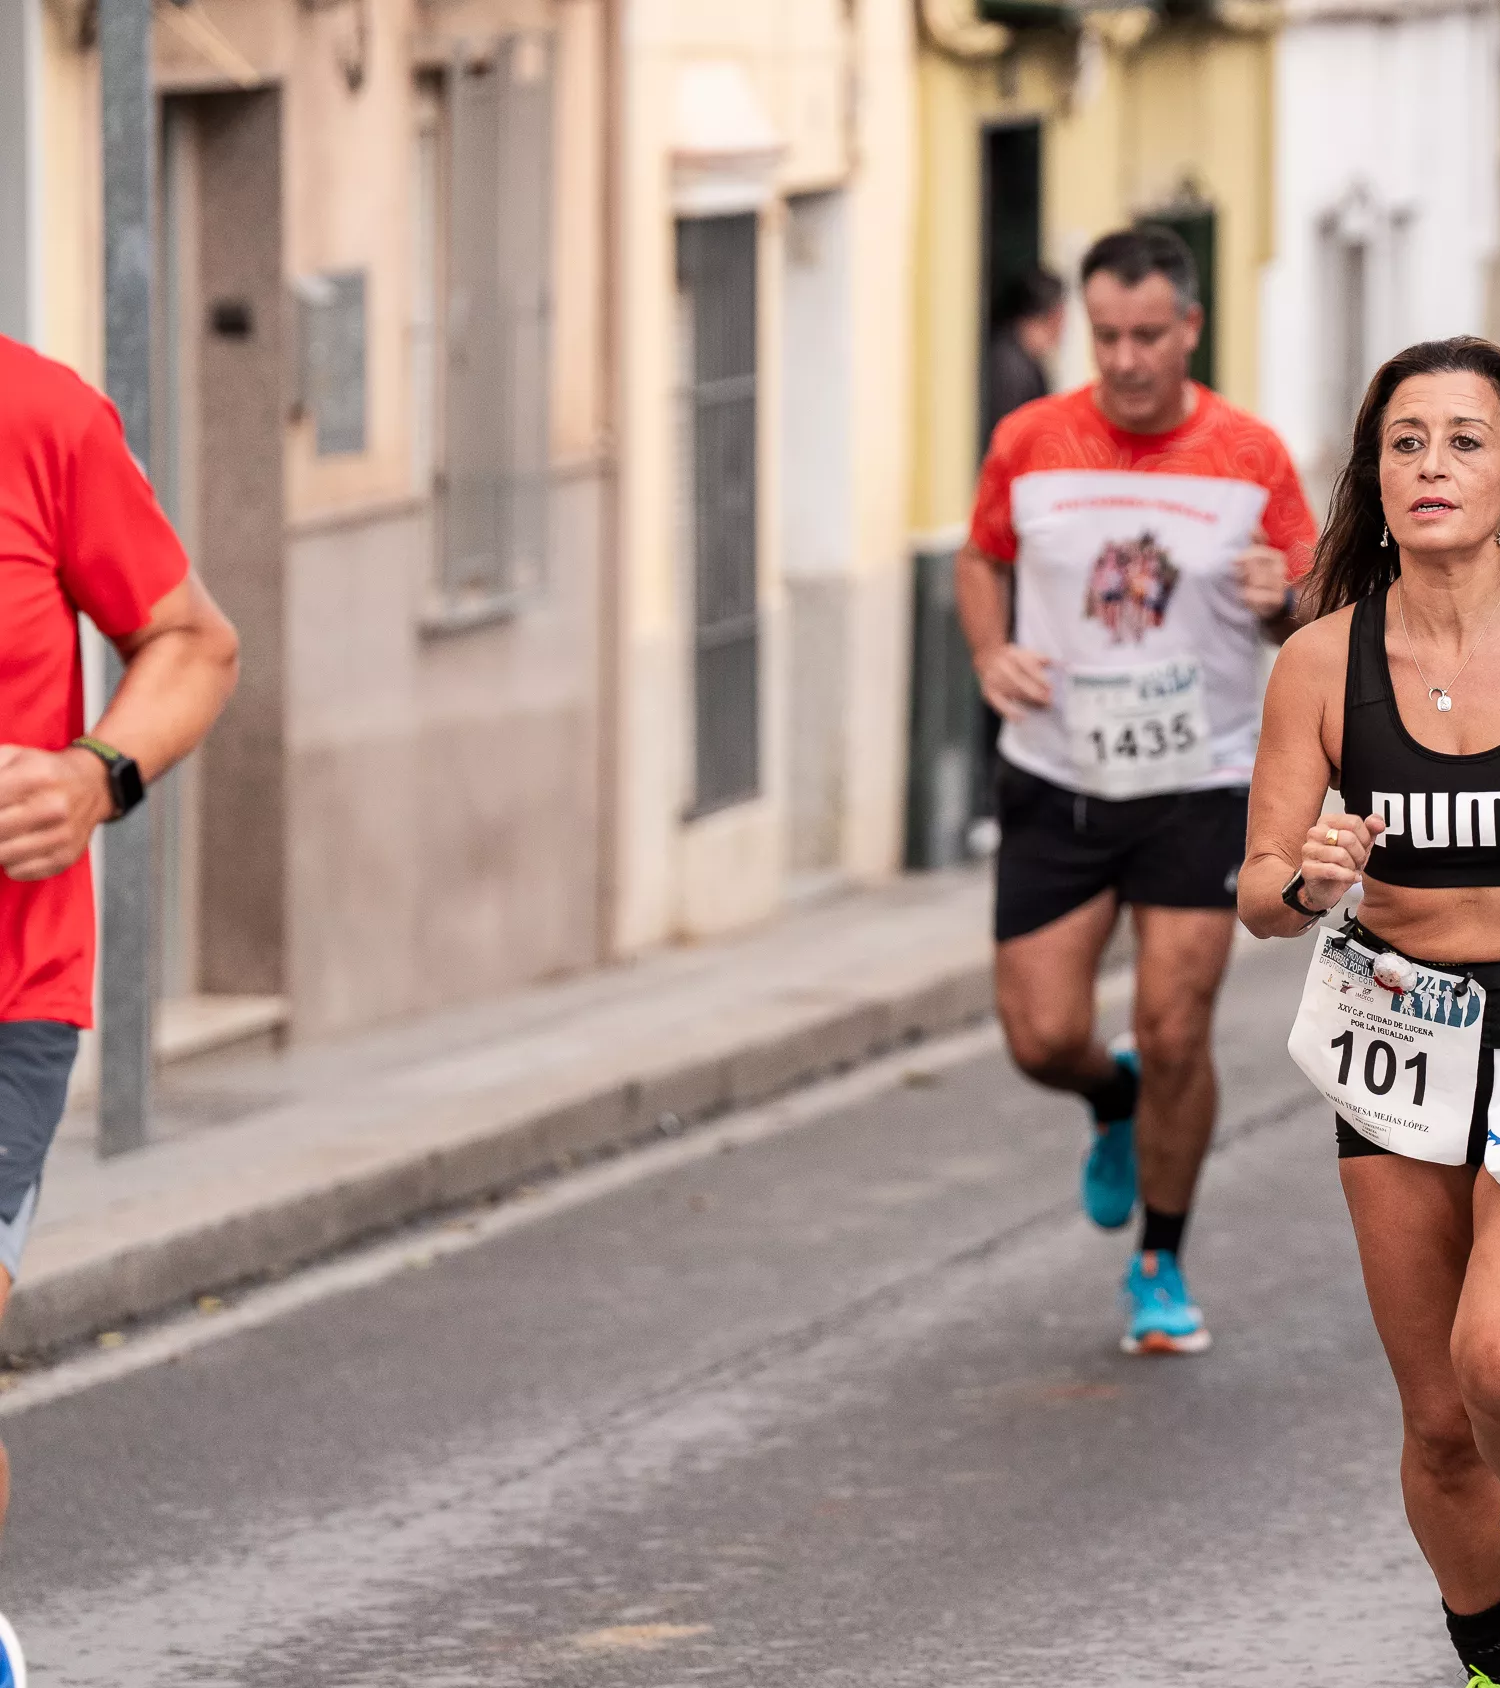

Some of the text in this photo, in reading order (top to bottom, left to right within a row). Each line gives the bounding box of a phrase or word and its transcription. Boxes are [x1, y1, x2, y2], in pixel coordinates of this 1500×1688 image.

[1087, 711, 1198, 763] 1435
[1349, 960, 1376, 979] POPUL
[1358, 976, 1378, 988] CORD
[1350, 1018, 1414, 1043] POR LA IGUALDAD
[1366, 1012, 1393, 1026] CIUDAD
[1393, 1020, 1404, 1030] DE
[1404, 1023, 1434, 1037] LUCENA
[1331, 1030, 1427, 1106] 101
[1344, 1101, 1372, 1117] TERESA
[1373, 1111, 1402, 1126] MEJÍAS
[1403, 1119, 1430, 1133] LÓPEZ
